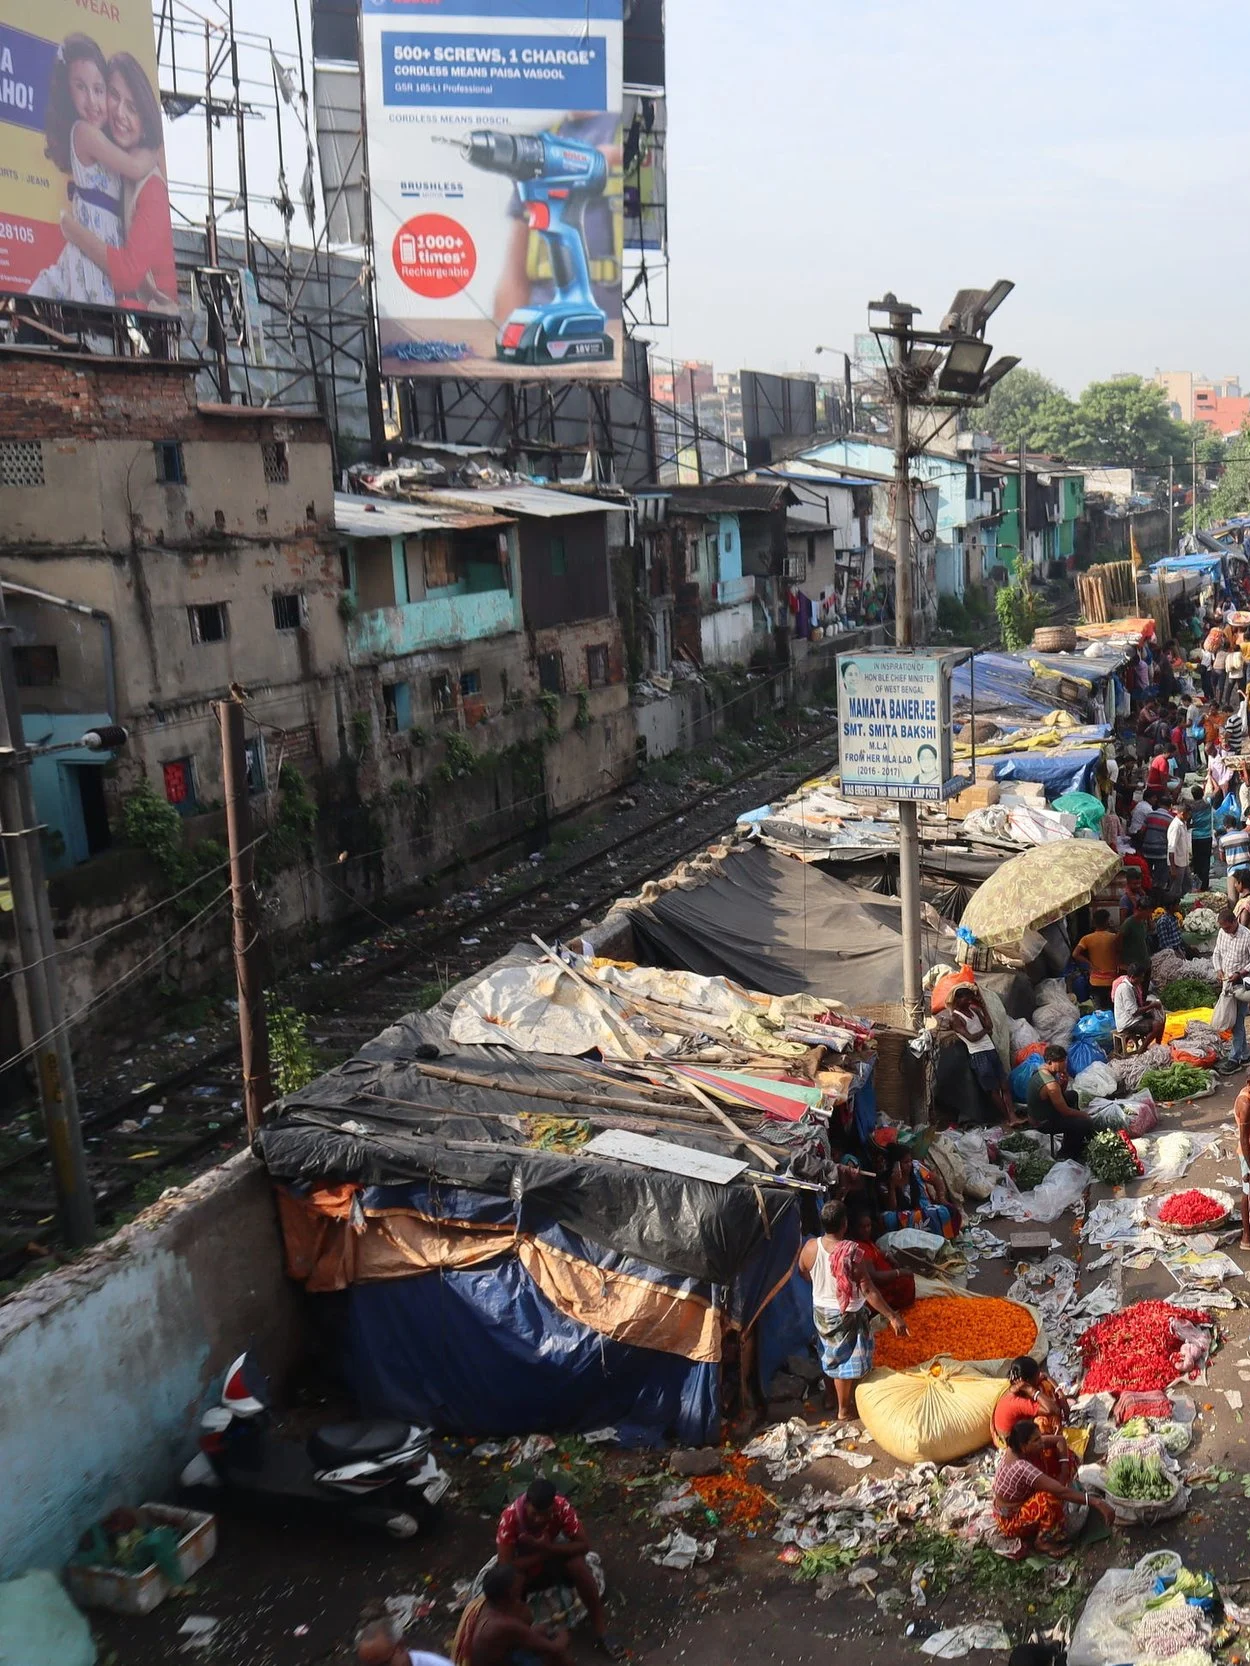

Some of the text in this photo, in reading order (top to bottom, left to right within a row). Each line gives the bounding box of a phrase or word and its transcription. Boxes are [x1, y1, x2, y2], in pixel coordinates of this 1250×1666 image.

[394, 46, 431, 61] 500+
[434, 47, 506, 65] SCREWS,
[509, 48, 518, 63] 1
[394, 65, 566, 80] CORDLESS MEANS PAISA VASOOL
[443, 83, 493, 94] Professional
[0, 78, 34, 112] HO!
[388, 113, 438, 123] CORDLESS
[440, 114, 473, 124] MEANS
[400, 181, 464, 191] BRUSHLESS
[416, 234, 464, 250] 1000+
[401, 264, 470, 280] Rechargeable
[874, 662, 924, 672] IN INSPIRATION OF
[890, 674, 907, 683] CHIEF
[907, 675, 935, 683] MINISTER
[875, 685, 924, 694] OF WEST BENGAL
[849, 697, 936, 721] MAMATA BANERJEE
[843, 722, 936, 739] SMT. SMITA BAKSHI
[845, 753, 912, 764] FROM HER MLA LAD
[857, 766, 876, 776] (2016
[882, 767, 900, 778] 2017)
[925, 788, 938, 799] POST
